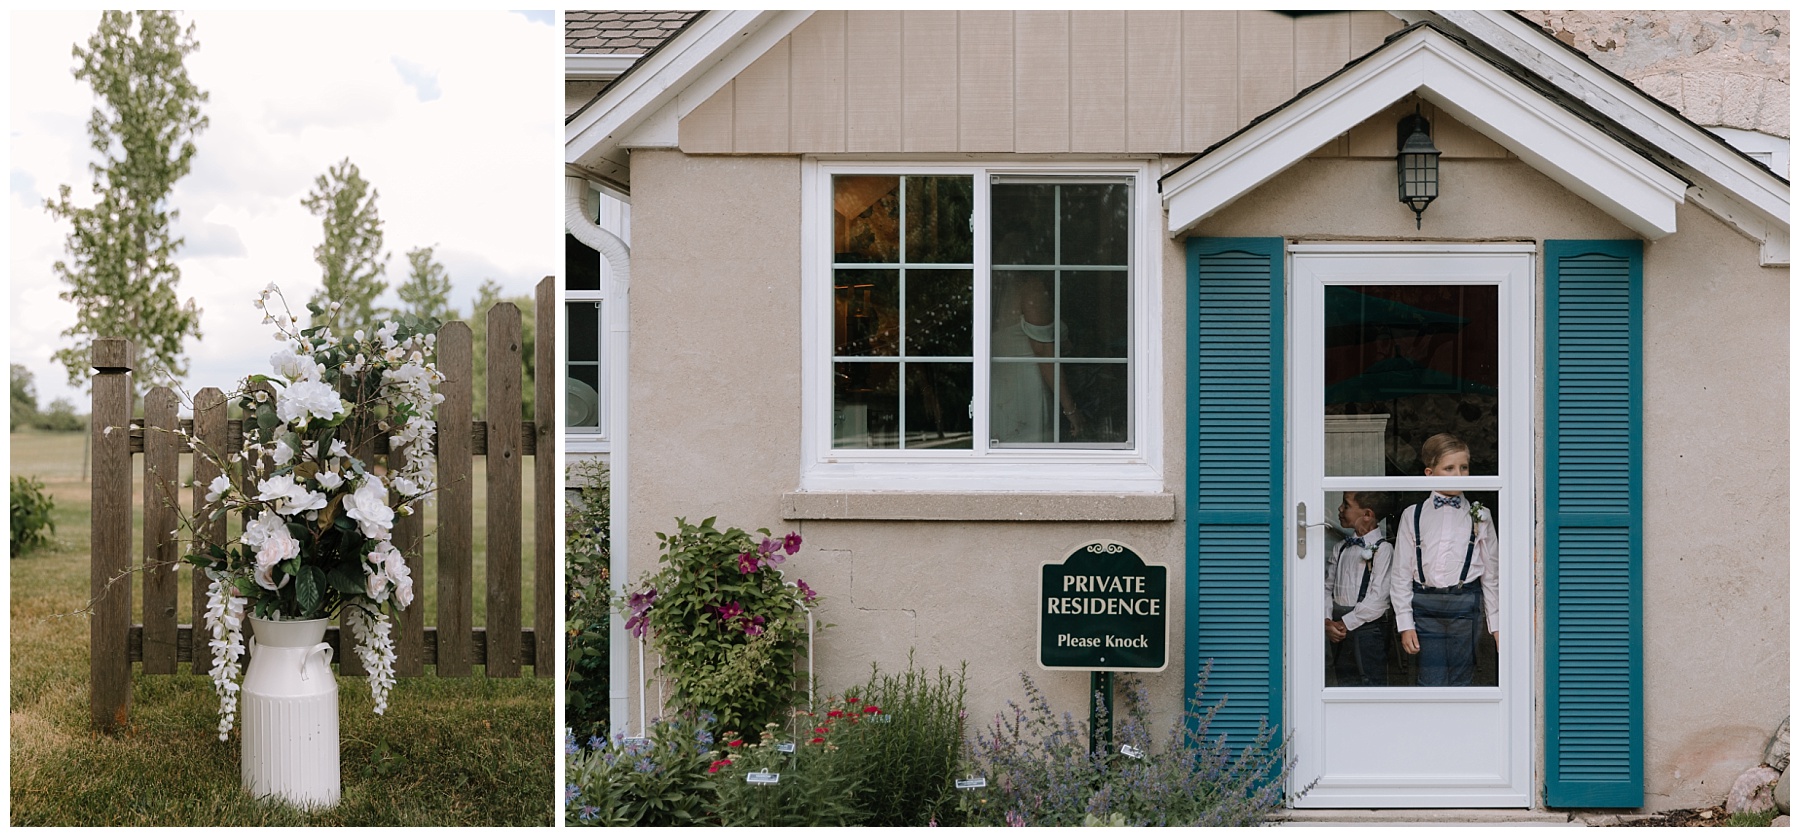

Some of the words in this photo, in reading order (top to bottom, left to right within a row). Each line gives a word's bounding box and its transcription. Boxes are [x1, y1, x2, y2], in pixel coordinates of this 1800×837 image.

[1063, 575, 1146, 593] PRIVATE
[1047, 597, 1160, 616] RESIDENCE
[1057, 633, 1101, 648] Please
[1105, 634, 1149, 648] Knock
